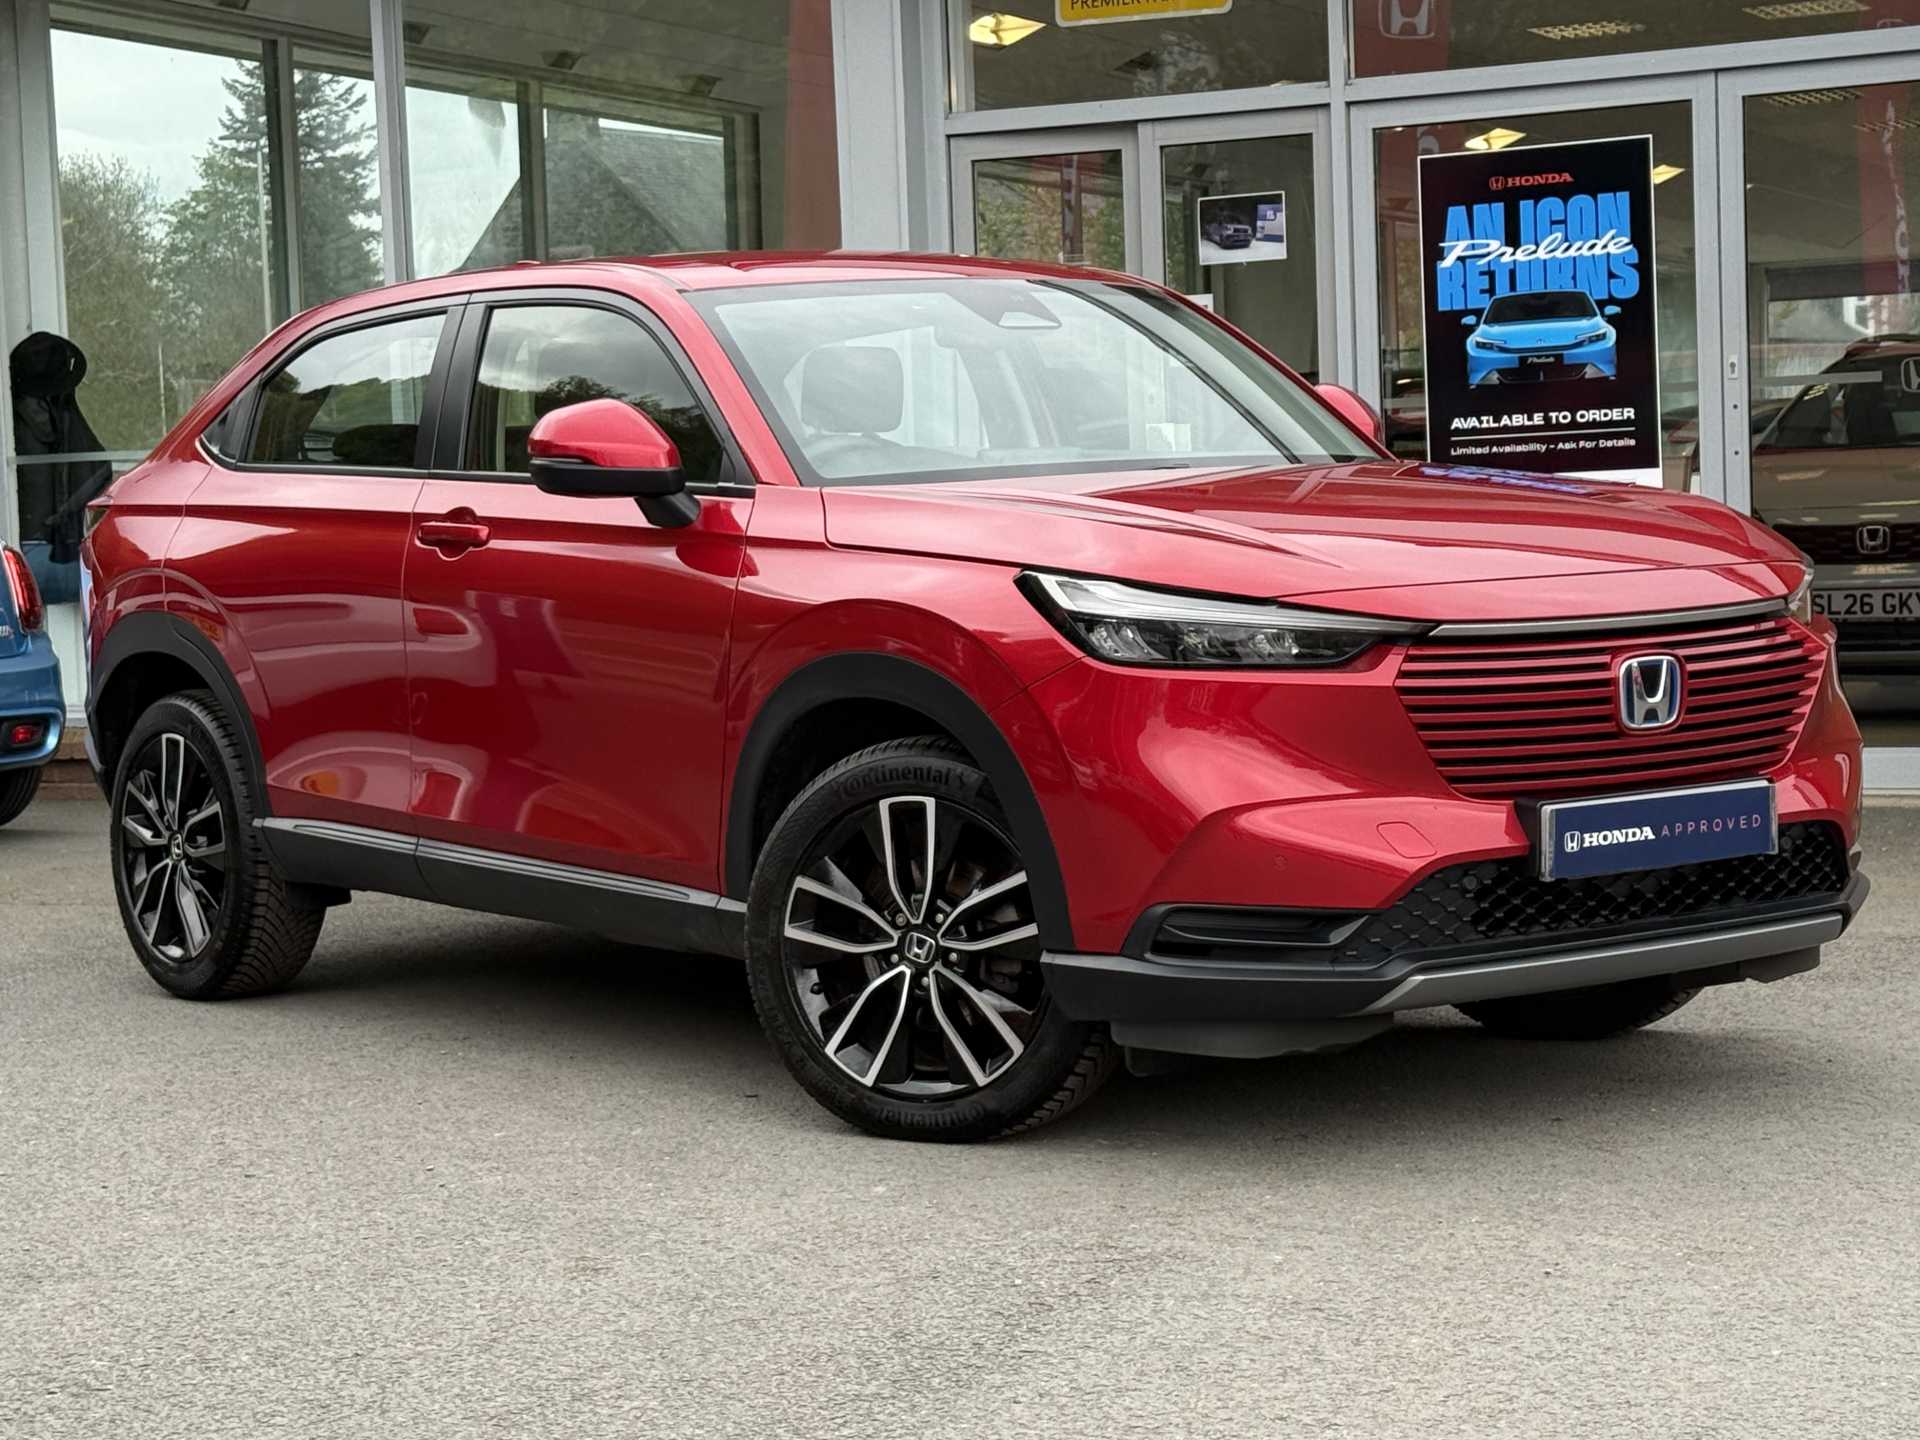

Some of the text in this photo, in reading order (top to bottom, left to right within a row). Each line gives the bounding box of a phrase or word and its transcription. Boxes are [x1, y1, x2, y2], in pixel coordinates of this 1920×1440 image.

[1507, 172, 1575, 187] HONDA
[1444, 191, 1632, 256] AN ICON
[1439, 229, 1633, 268] Prelude
[1437, 246, 1640, 311] RETURNS
[1450, 407, 1635, 430] AVAILABLE TO ORDER
[1450, 445, 1490, 456] Limited
[1492, 442, 1547, 455] Availability
[1557, 440, 1577, 450] Ask
[1579, 439, 1597, 449] For
[1599, 437, 1636, 448] Details
[1813, 592, 1874, 615] SL26
[841, 764, 951, 796] Continental
[1582, 814, 1762, 847] HONDA APPROVED
